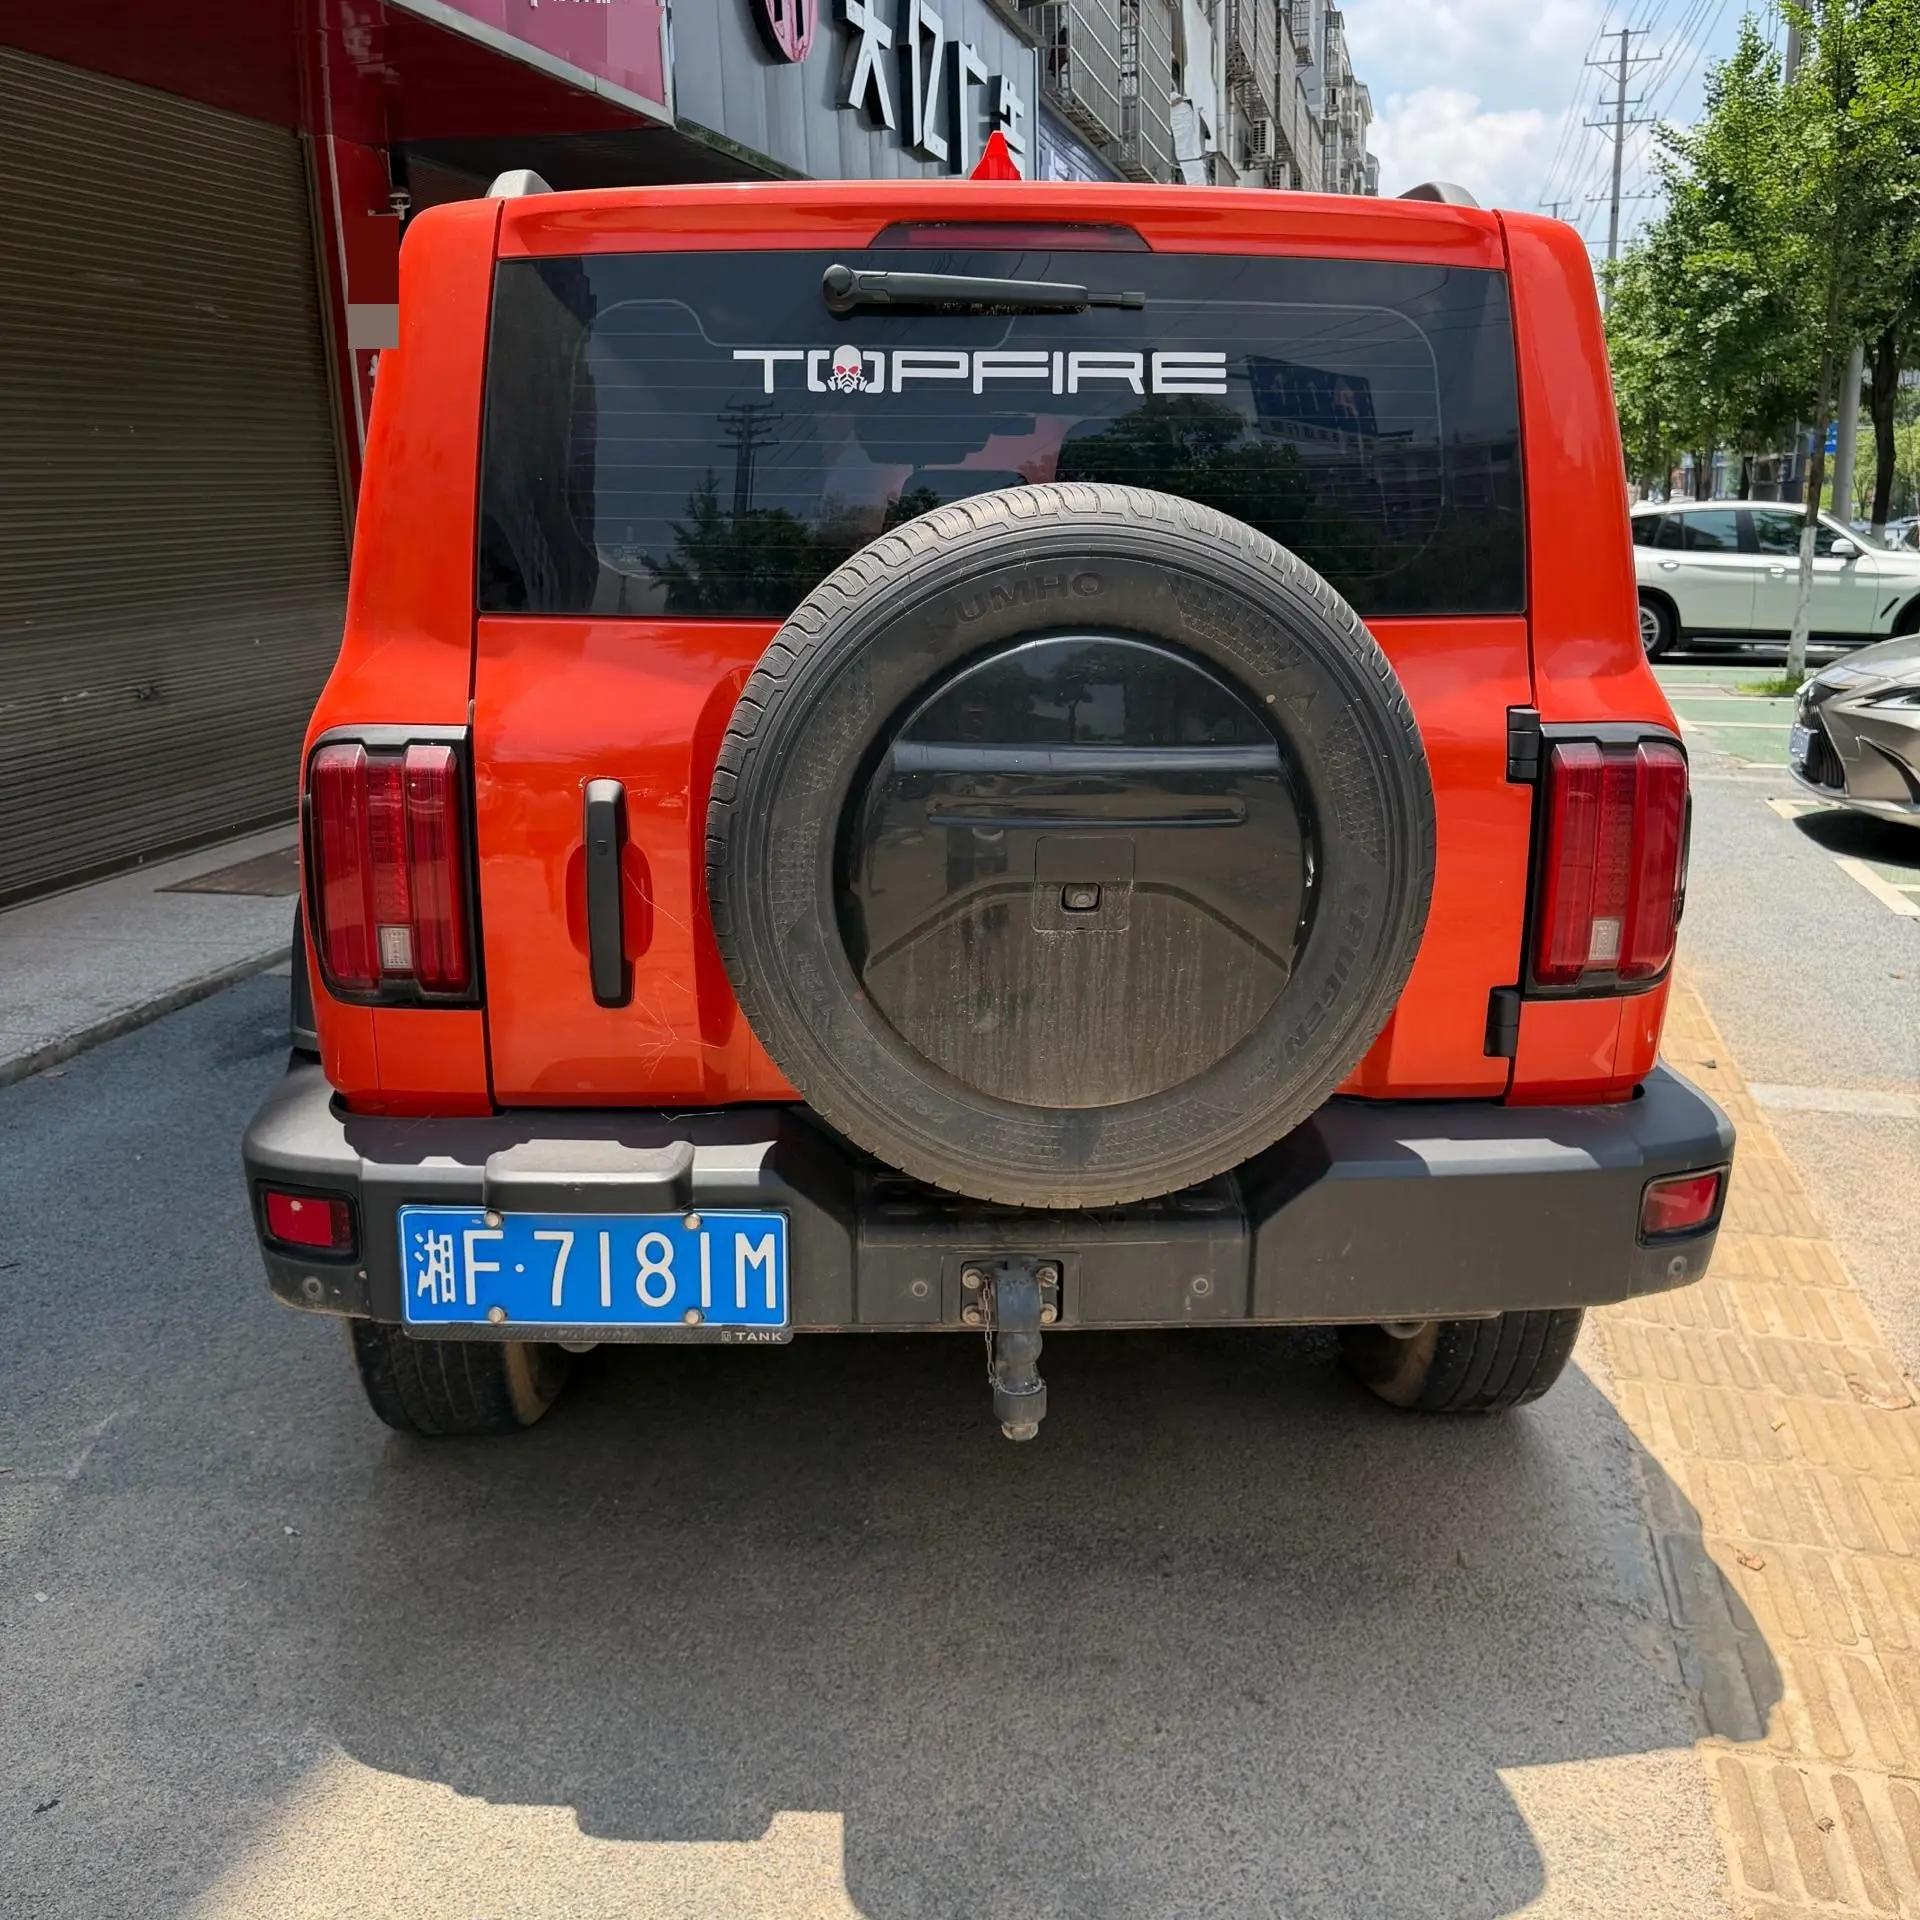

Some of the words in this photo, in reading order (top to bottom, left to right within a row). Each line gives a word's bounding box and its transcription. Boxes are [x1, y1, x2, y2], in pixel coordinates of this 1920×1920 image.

[733, 345, 1228, 395] TOPFIRE
[942, 568, 1103, 630] UMHO
[735, 1331, 783, 1342] TANK
